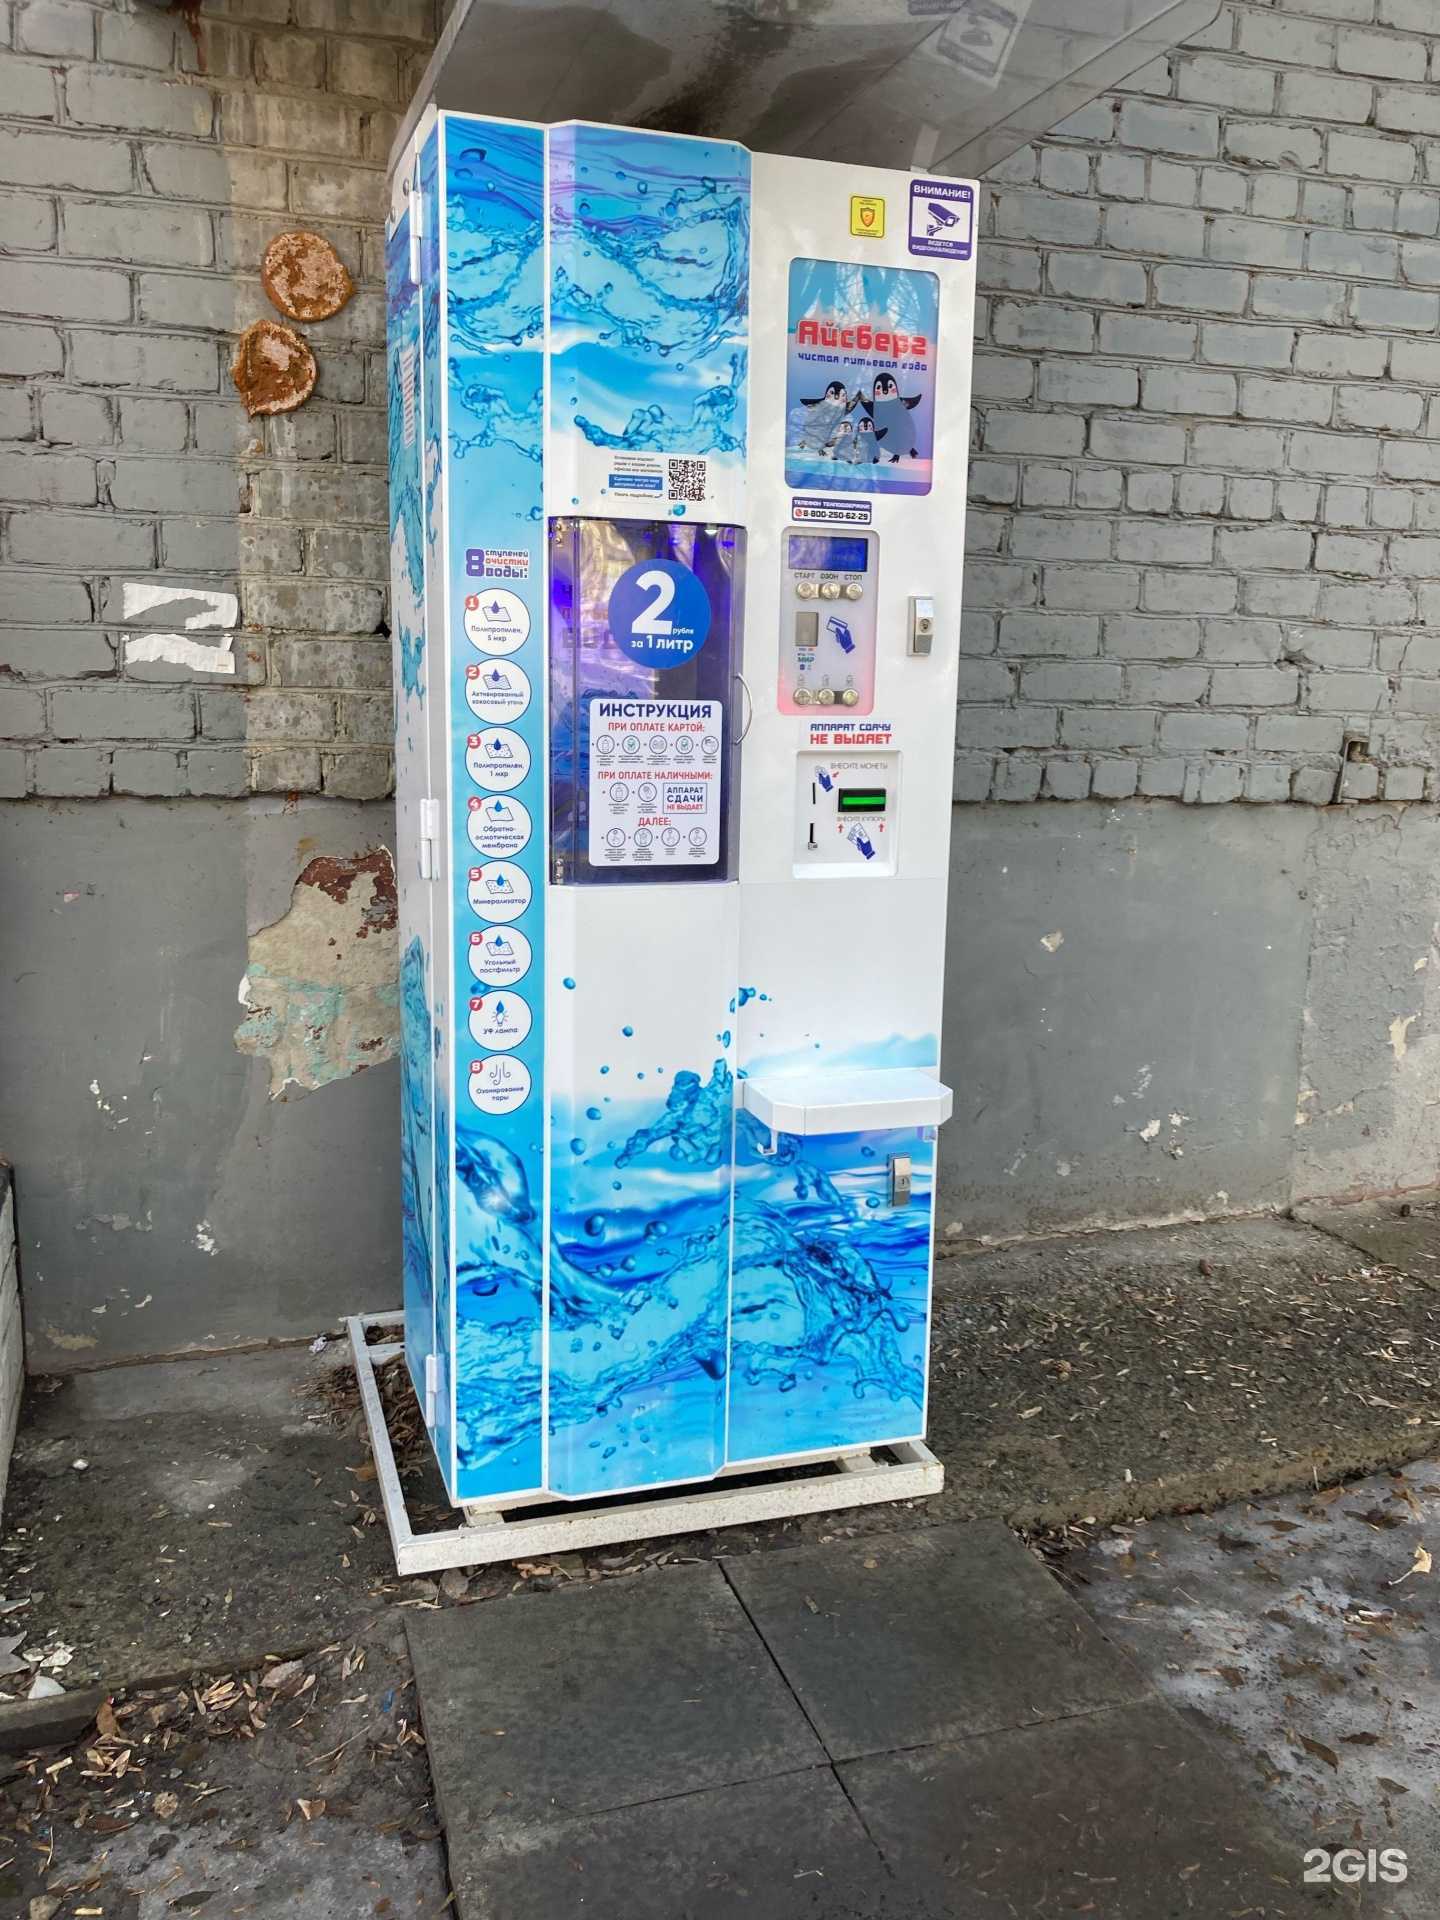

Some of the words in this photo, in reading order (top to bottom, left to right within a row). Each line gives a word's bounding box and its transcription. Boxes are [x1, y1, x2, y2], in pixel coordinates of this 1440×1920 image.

[914, 184, 971, 199] ВНИМАНИЕ!
[798, 320, 927, 358] Айсберг
[798, 352, 839, 363] чистая
[843, 356, 898, 369] питьевая
[803, 509, 868, 520] 8-800-250-62-29
[466, 549, 485, 576] 8
[485, 557, 528, 566] очистки
[486, 566, 527, 578] воды:
[794, 571, 816, 579] СТАРТ
[820, 572, 839, 580] ОЗОН
[632, 570, 675, 635] 2
[672, 627, 694, 635] рубля
[631, 639, 644, 648] за
[646, 635, 653, 648] 1
[656, 639, 694, 653] литр
[468, 667, 477, 677] 2
[600, 703, 712, 720] ИНСТРУКЦИЯ
[608, 722, 626, 731] ПРИ
[630, 722, 665, 732] ОПЛАТЕ
[668, 721, 705, 732] КАРТОЙ:
[810, 723, 855, 732] АППАРАТ
[860, 723, 891, 732] СДАЧУ
[810, 733, 828, 744] НЕ
[834, 733, 892, 745] ВЫДАЕТ
[860, 762, 888, 770] МОНЕТЫ
[598, 771, 616, 779] ПРИ
[618, 771, 652, 780] ОПЛАТЕ
[655, 771, 712, 780] НАЛИЧНЫМИ:
[667, 786, 703, 794] АППАРАТ
[667, 794, 704, 803] СДАЧИ
[677, 803, 703, 811] ВЫДАЕТ
[638, 817, 671, 827] ДАЛЕЕ:
[471, 869, 480, 880] 5
[471, 933, 481, 944] 6
[472, 999, 481, 1009] 7
[471, 1062, 481, 1072] 8
